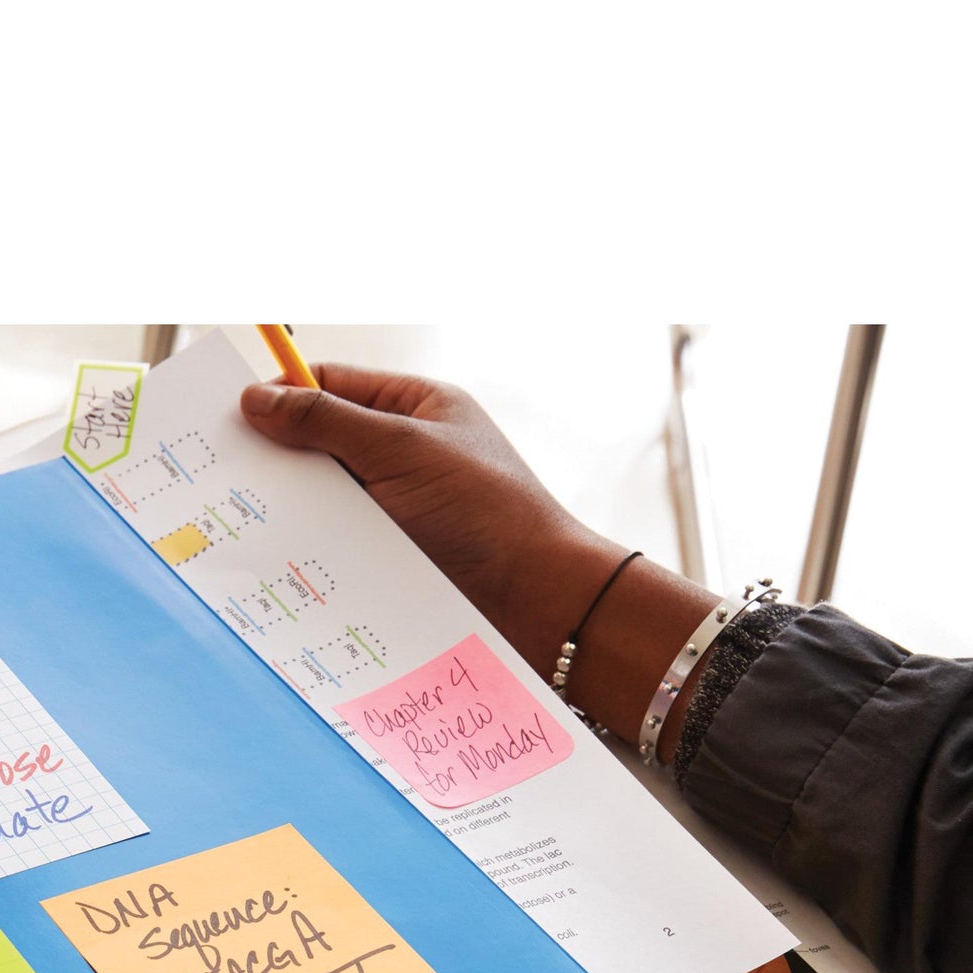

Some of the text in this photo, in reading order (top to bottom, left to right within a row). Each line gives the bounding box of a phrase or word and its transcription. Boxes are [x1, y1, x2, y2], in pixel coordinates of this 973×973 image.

[74, 386, 106, 450] Start
[105, 386, 134, 439] Here
[363, 656, 479, 737] Chapter 4
[402, 702, 493, 761] Review
[415, 713, 554, 797] for Monday
[434, 794, 513, 826] be replicated in
[453, 825, 468, 835] on
[469, 811, 511, 830] different
[488, 848, 563, 878] pound. The lac
[495, 836, 556, 862] metabolizes
[497, 878, 509, 888] of
[508, 859, 574, 885] transcription.
[75, 883, 178, 936] DNA
[555, 889, 566, 900] or
[567, 887, 577, 895] a
[139, 886, 299, 970] Sequence:
[557, 928, 578, 941] coli.
[662, 925, 676, 939] 2
